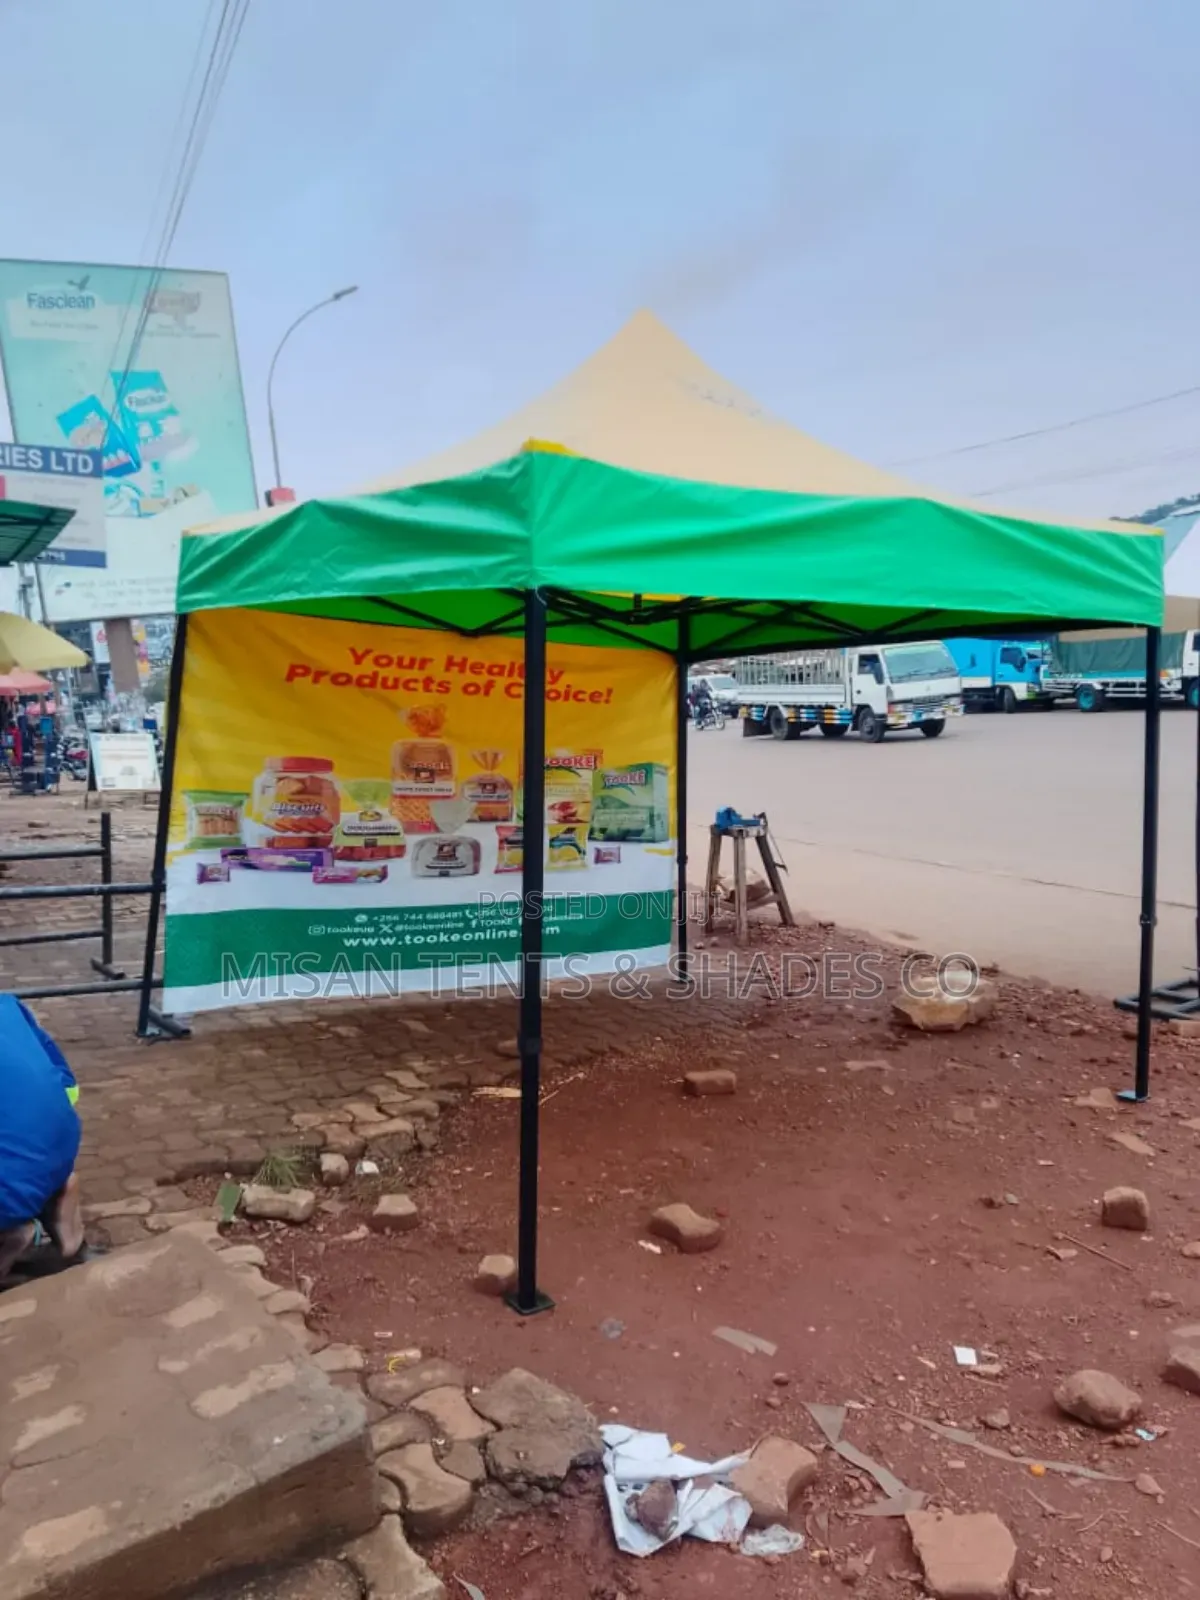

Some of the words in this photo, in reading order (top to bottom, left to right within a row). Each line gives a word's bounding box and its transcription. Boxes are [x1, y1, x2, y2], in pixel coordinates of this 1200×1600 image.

[27, 291, 96, 310] Fasclean
[0, 446, 43, 469] IES
[50, 450, 94, 474] LTD
[348, 647, 434, 672] Your
[444, 655, 564, 685] Healty
[284, 663, 451, 695] Products
[461, 679, 495, 698] of
[503, 682, 613, 705] Coice!
